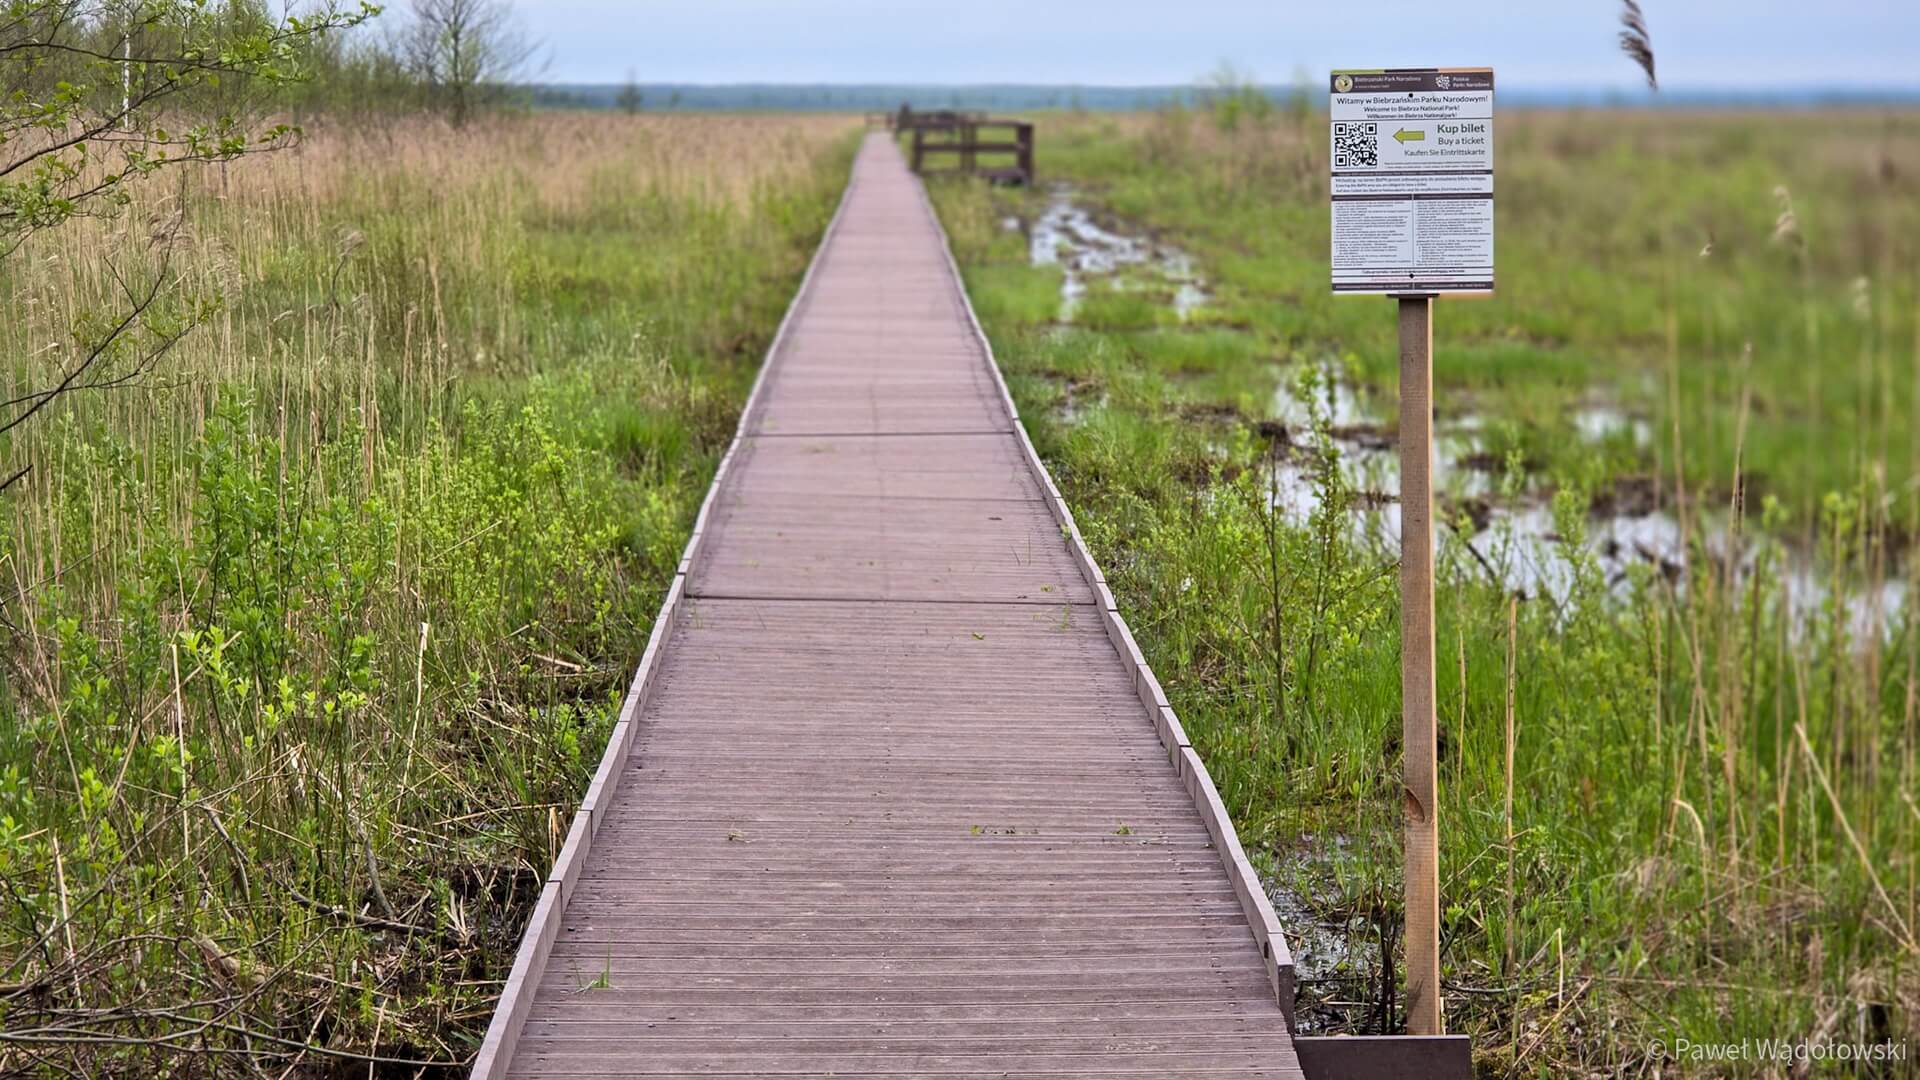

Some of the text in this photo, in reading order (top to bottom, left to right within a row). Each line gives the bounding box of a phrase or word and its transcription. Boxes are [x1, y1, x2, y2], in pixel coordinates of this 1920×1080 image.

[1337, 97, 1364, 105] Witamy
[1437, 124, 1485, 135] Kup bilet
[1438, 138, 1454, 146] Buy
[1441, 148, 1485, 156] Eintrittskarte
